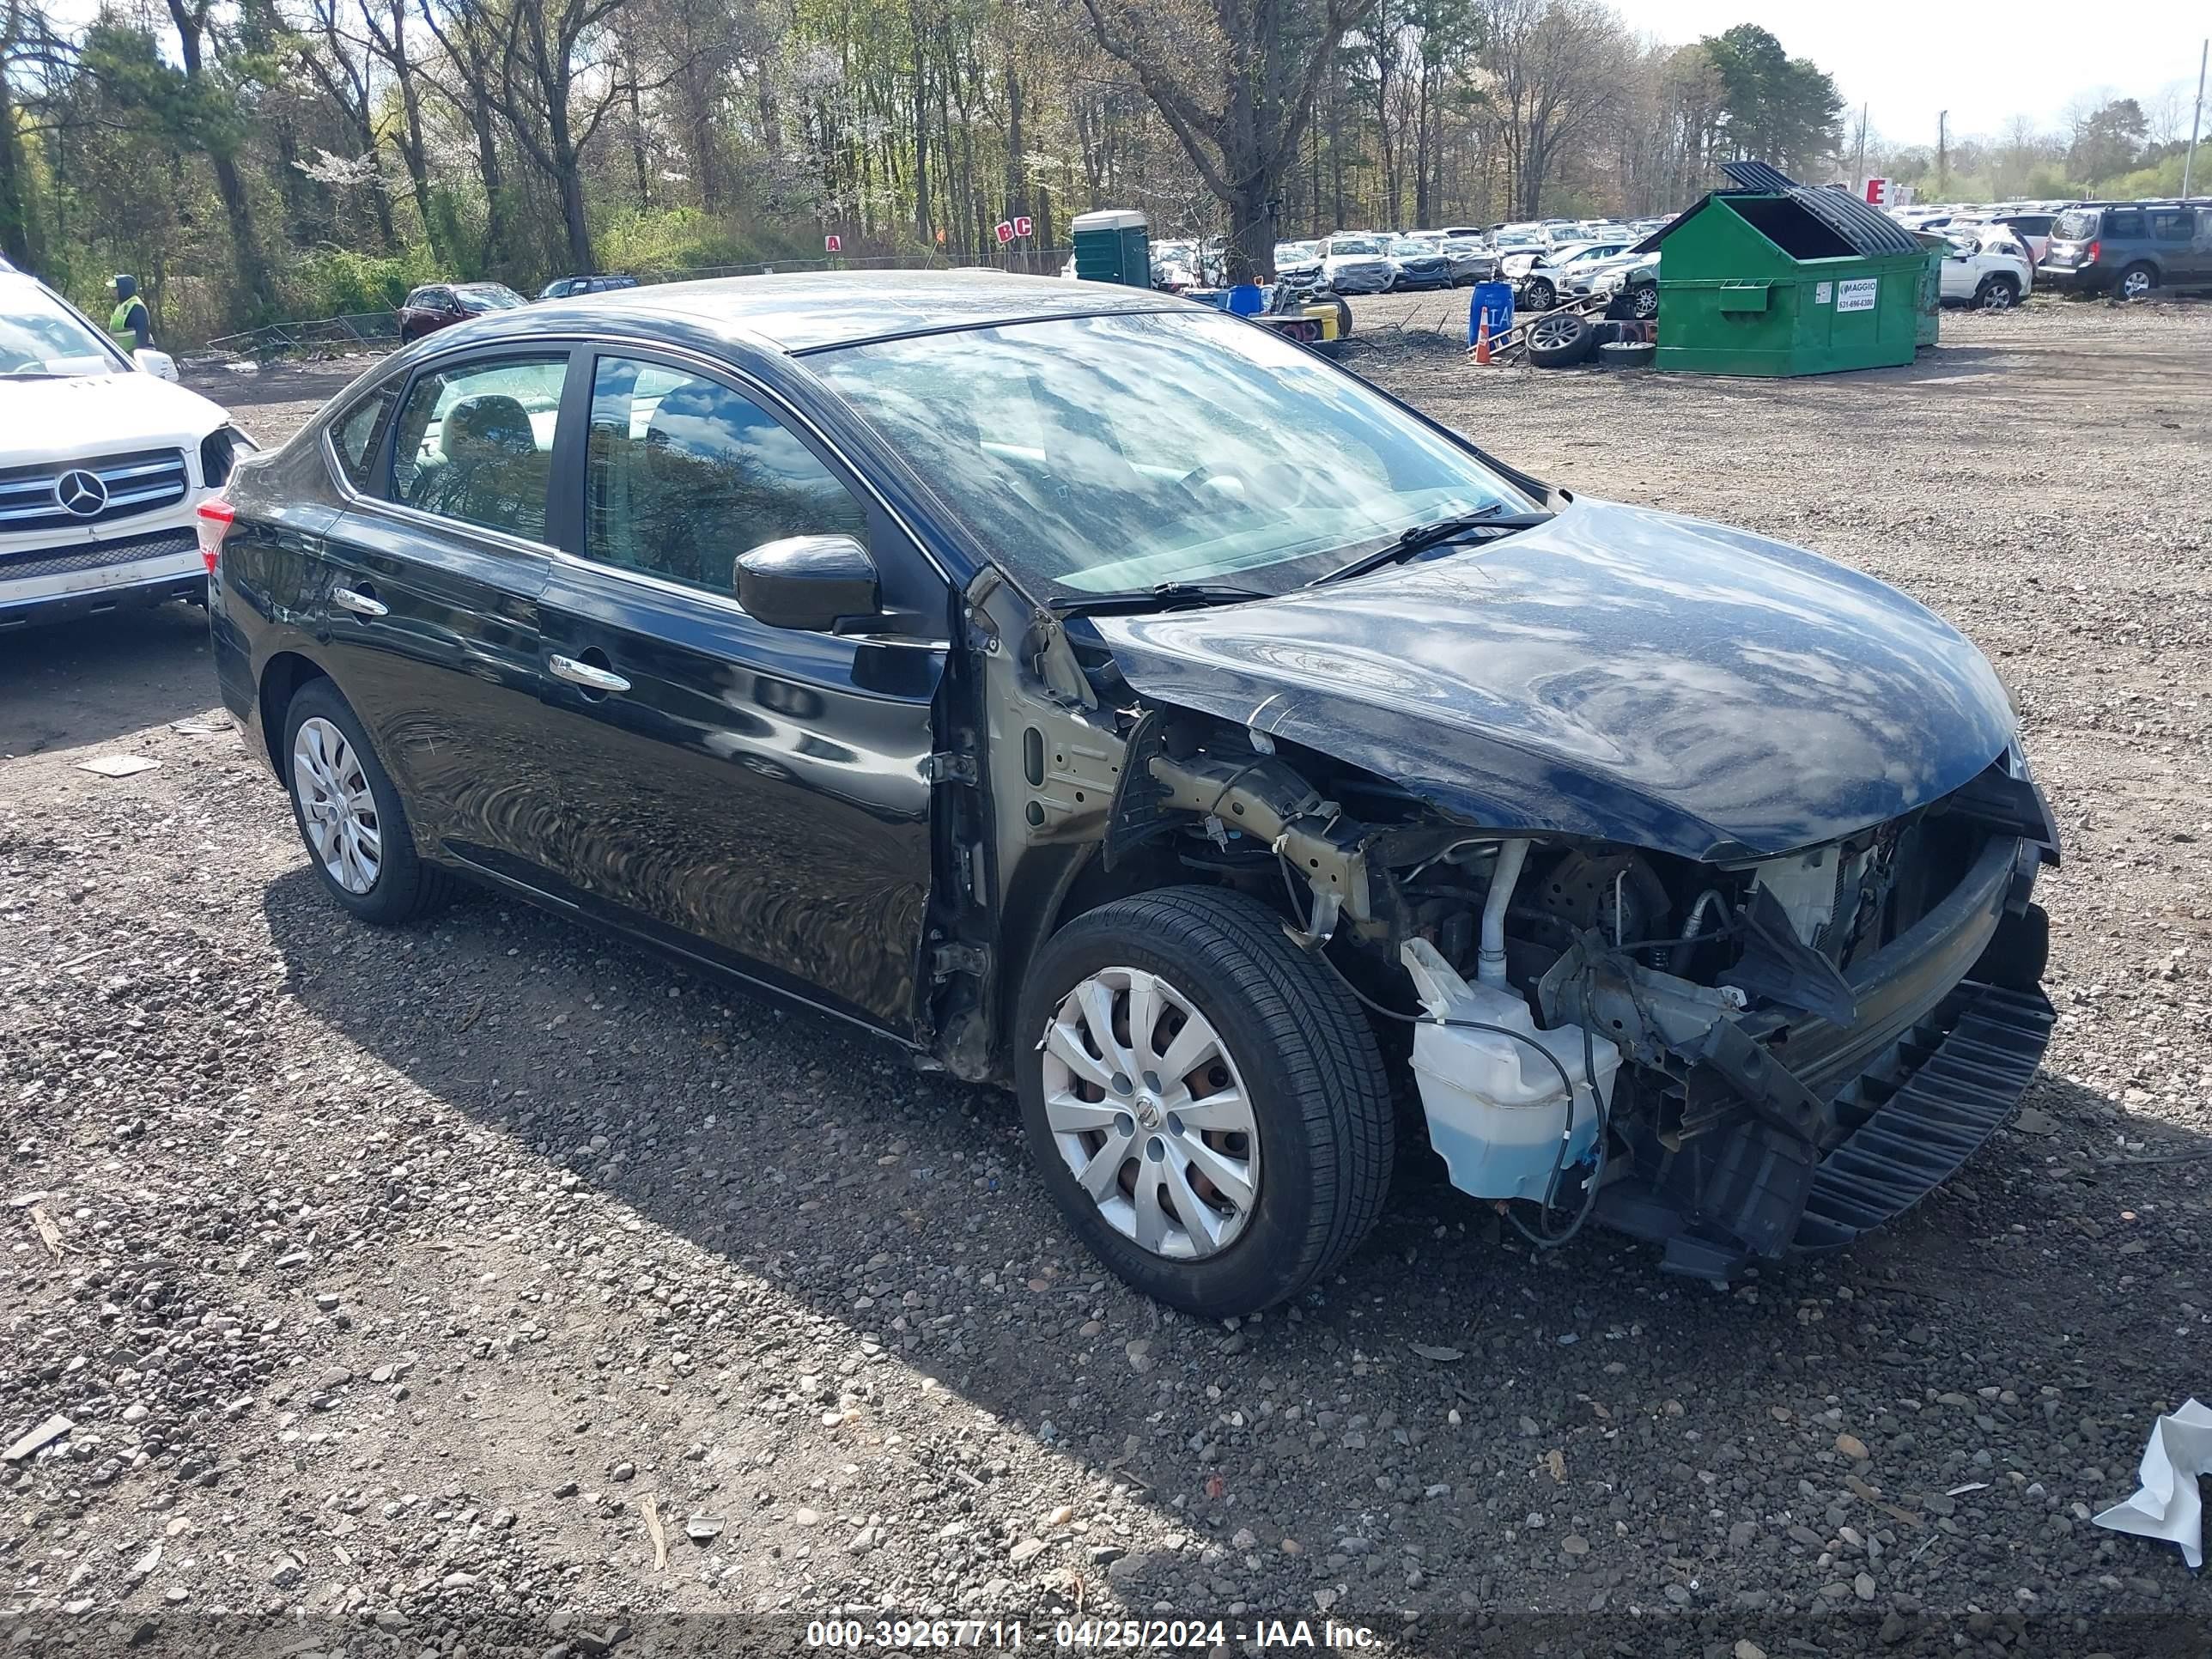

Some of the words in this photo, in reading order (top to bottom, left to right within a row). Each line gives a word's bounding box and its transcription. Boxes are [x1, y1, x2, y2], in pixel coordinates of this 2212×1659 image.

[1867, 179, 1886, 204] E
[998, 224, 1012, 241] B
[1017, 219, 1030, 235] C
[828, 237, 840, 250] A
[1846, 283, 1875, 292] MAGGIO
